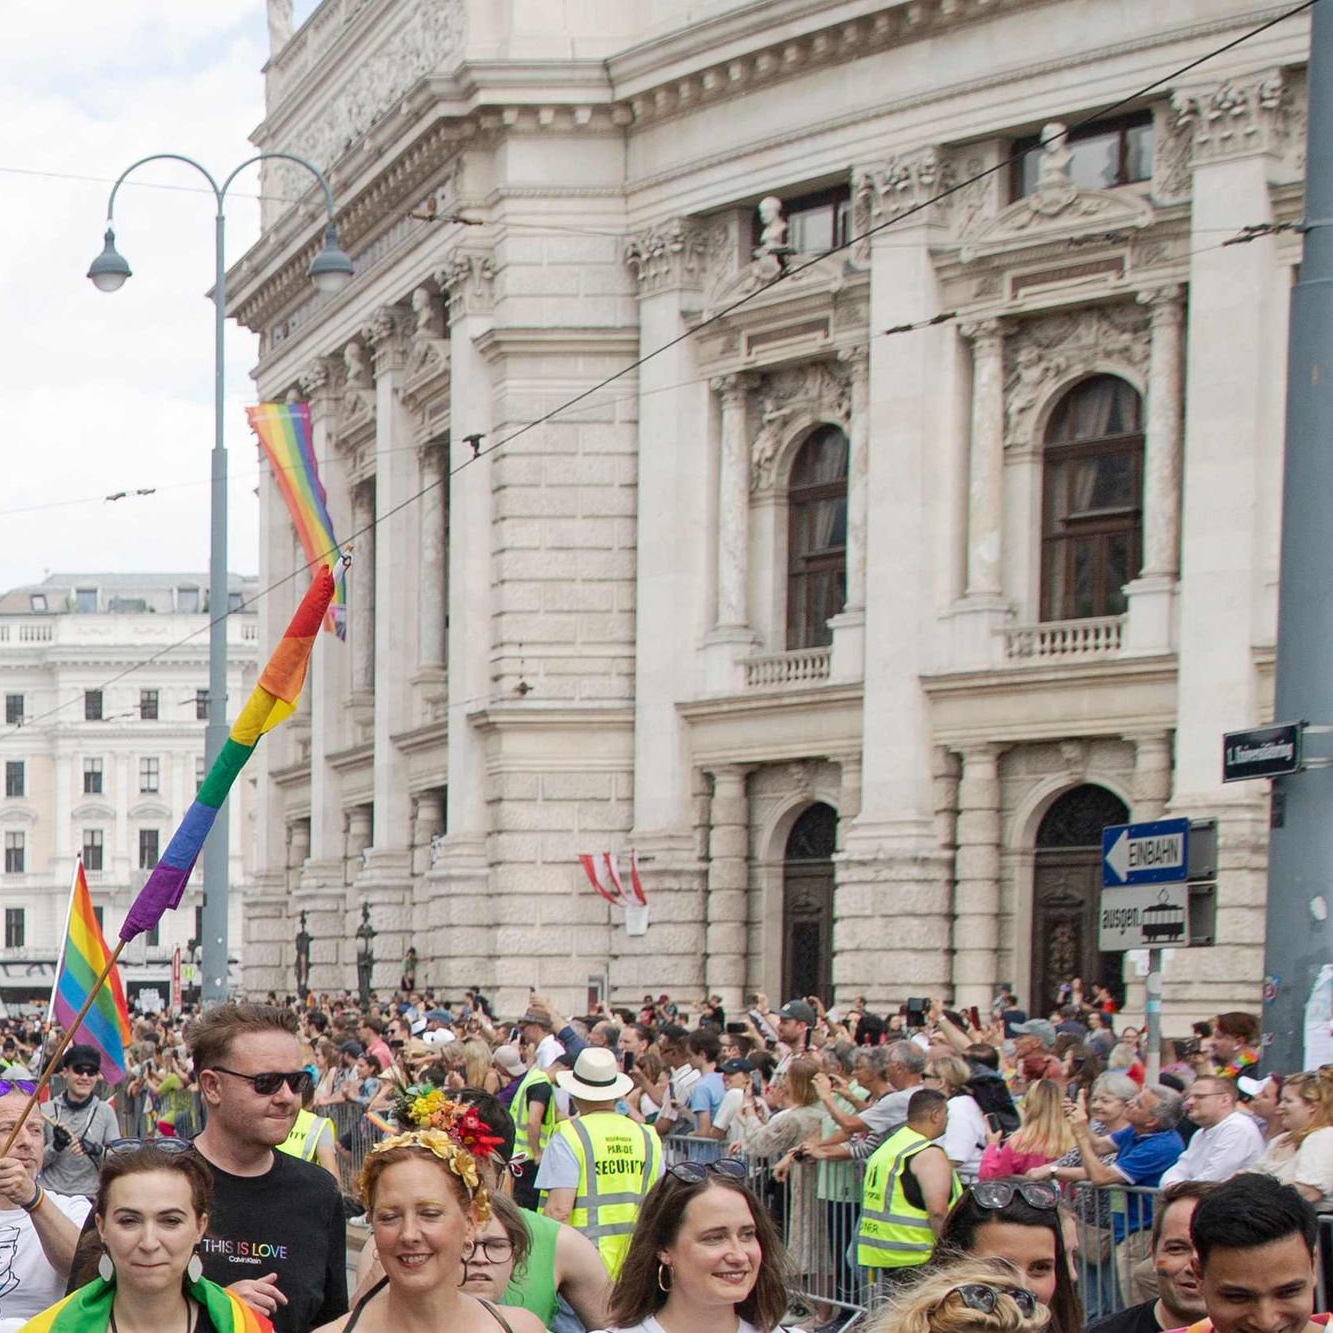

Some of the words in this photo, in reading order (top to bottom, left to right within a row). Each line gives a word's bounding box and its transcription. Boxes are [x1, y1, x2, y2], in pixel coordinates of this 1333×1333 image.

[1129, 836, 1179, 867] EINBAHN
[1102, 907, 1142, 936] ausgen.
[203, 1239, 233, 1254] THIS
[237, 1241, 249, 1255] IS
[252, 1242, 287, 1259] LOVE
